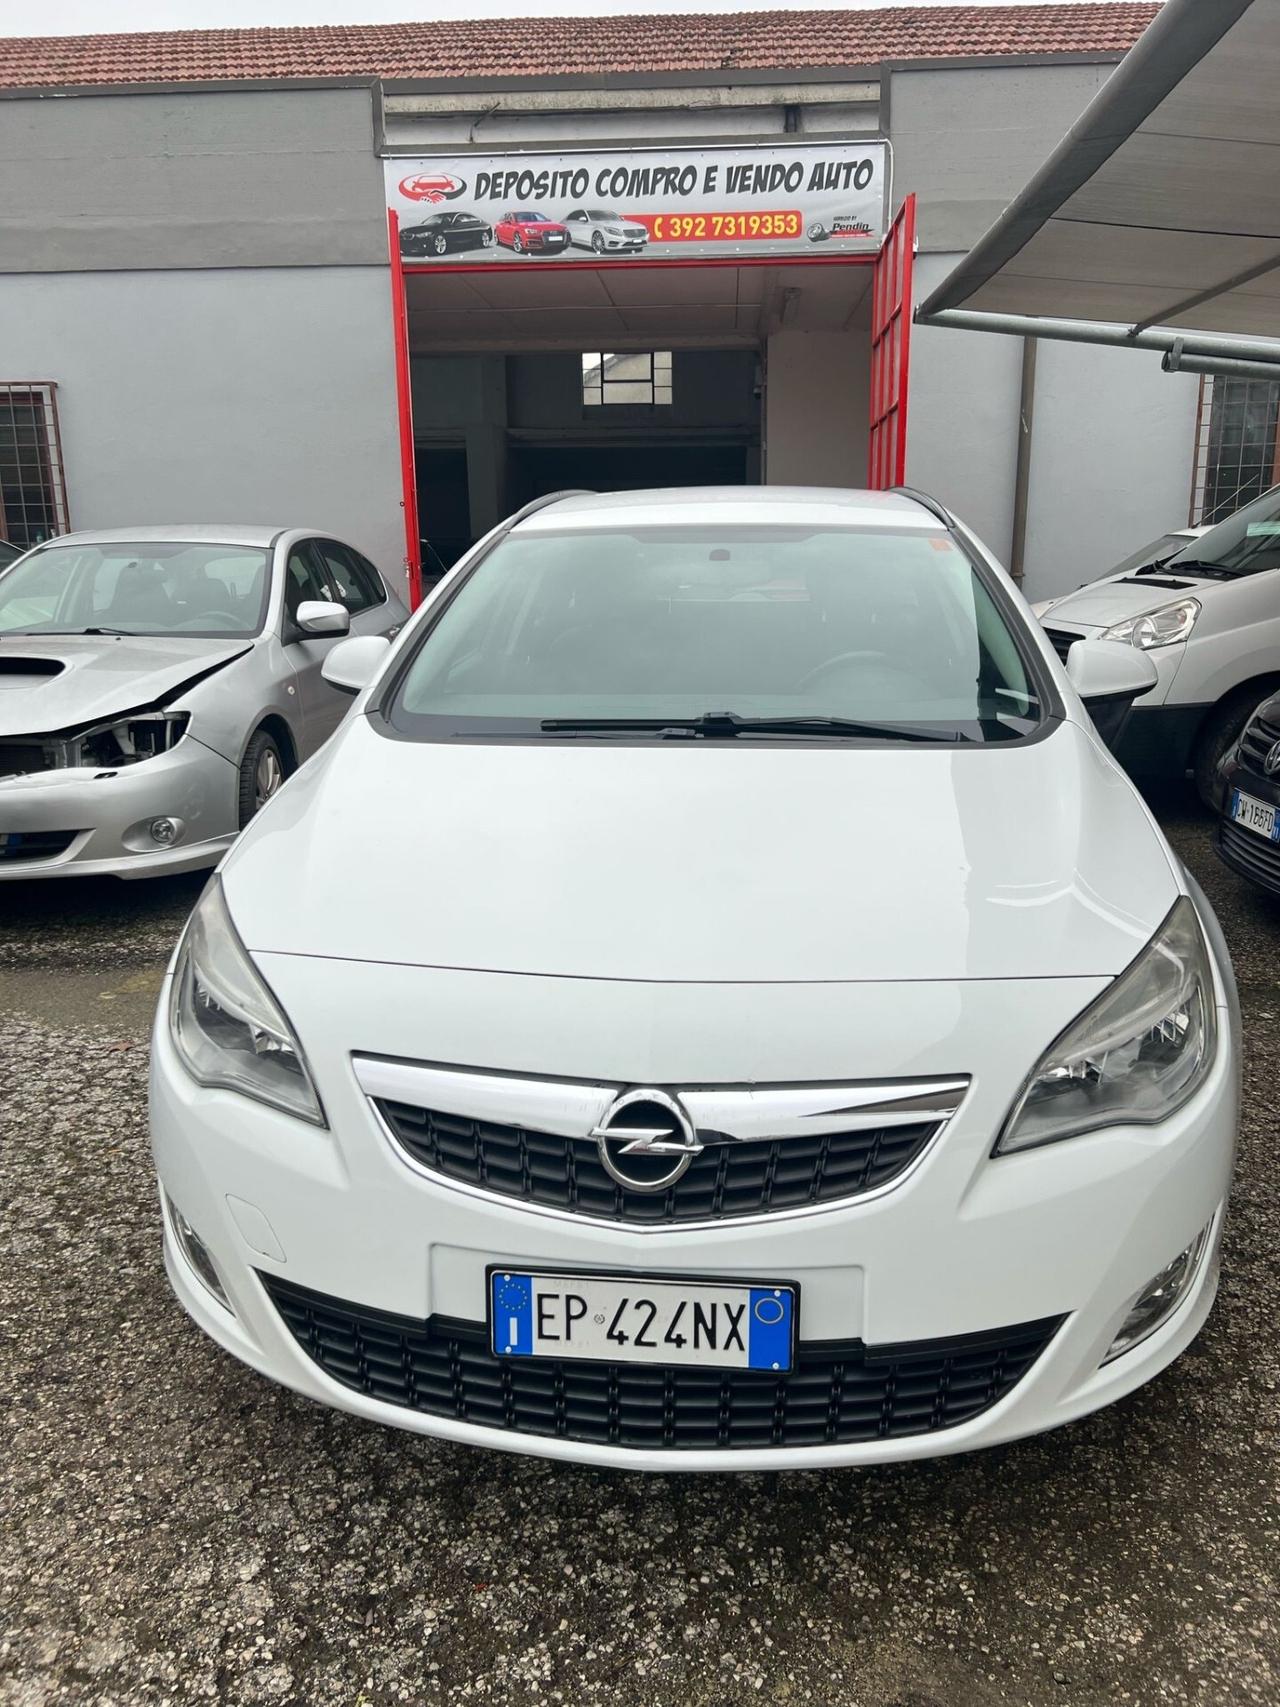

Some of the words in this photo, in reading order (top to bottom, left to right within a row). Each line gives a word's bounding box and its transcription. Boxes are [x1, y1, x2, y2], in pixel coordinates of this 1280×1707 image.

[474, 167, 589, 200] DEPOSITO
[595, 165, 698, 198] COMPRO
[702, 164, 718, 194] E
[725, 161, 804, 195] VENDO
[806, 158, 874, 192] AUTO
[669, 216, 706, 238] 392
[711, 214, 798, 236] 7319353
[509, 1317, 518, 1345] I
[537, 1293, 588, 1341] EP
[606, 1298, 746, 1352] 424NX
